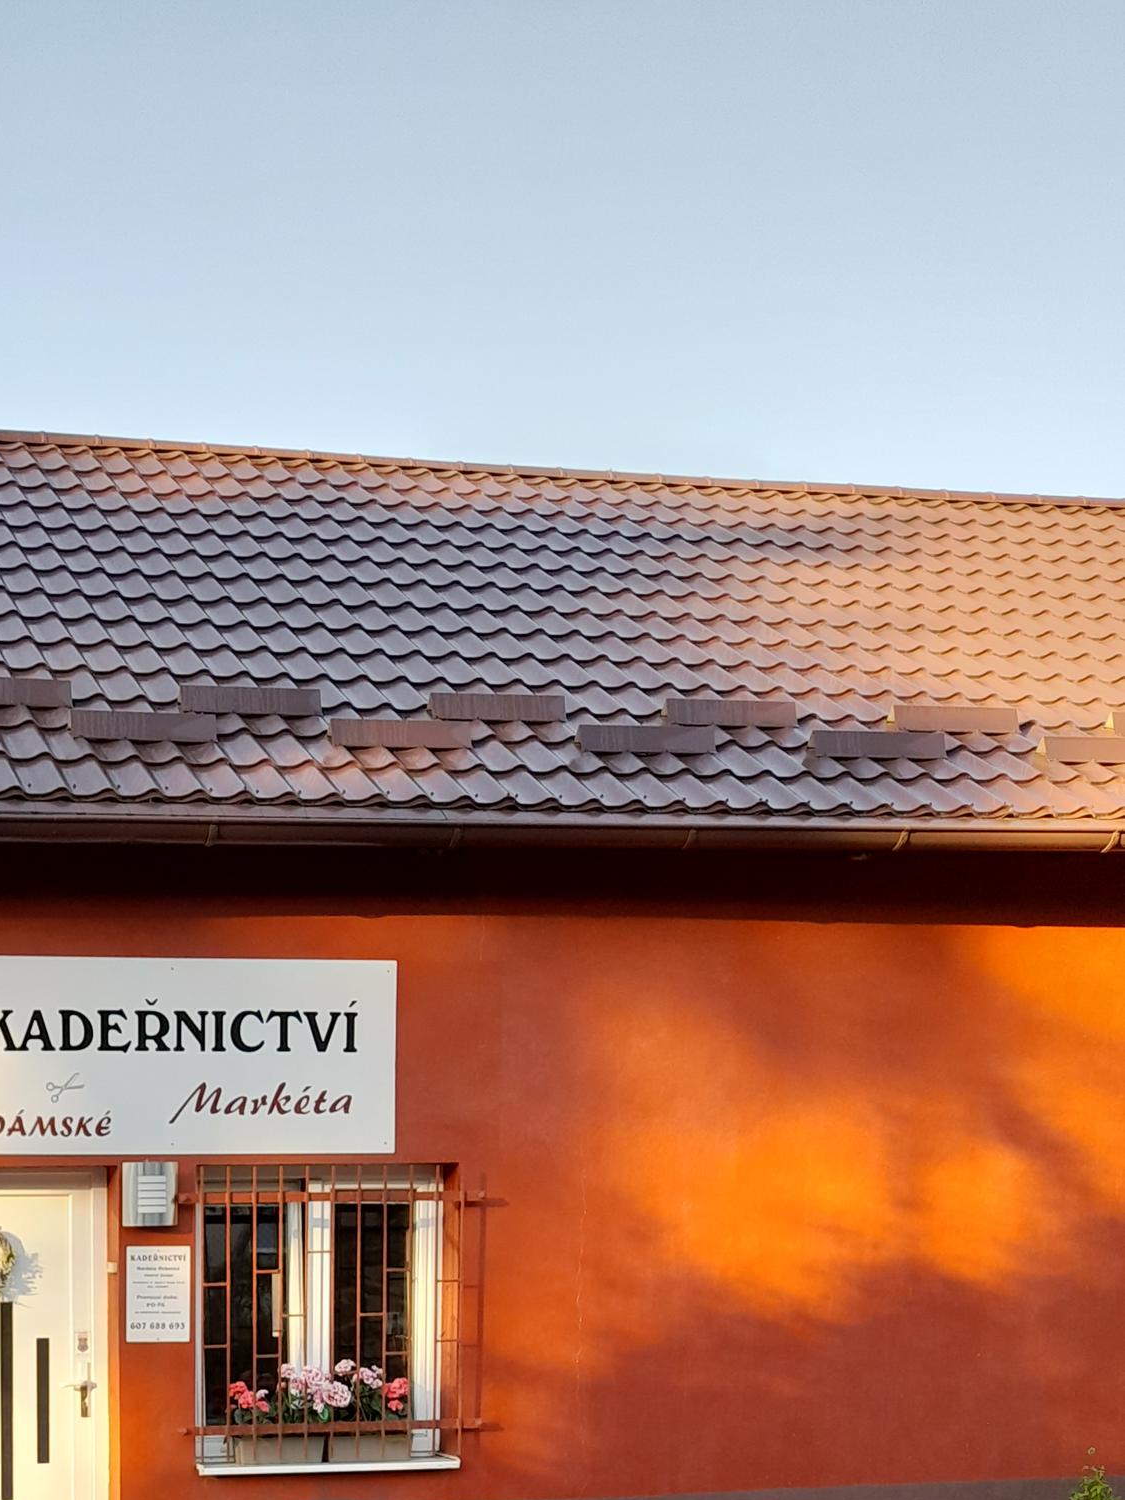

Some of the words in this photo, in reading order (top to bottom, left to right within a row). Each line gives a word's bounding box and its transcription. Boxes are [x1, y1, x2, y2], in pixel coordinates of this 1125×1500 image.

[169, 1082, 353, 1125] Markéta
[130, 1253, 187, 1262] KADEŘNICTVÍ
[130, 1322, 147, 1330] 607
[169, 1322, 186, 1330] 693
